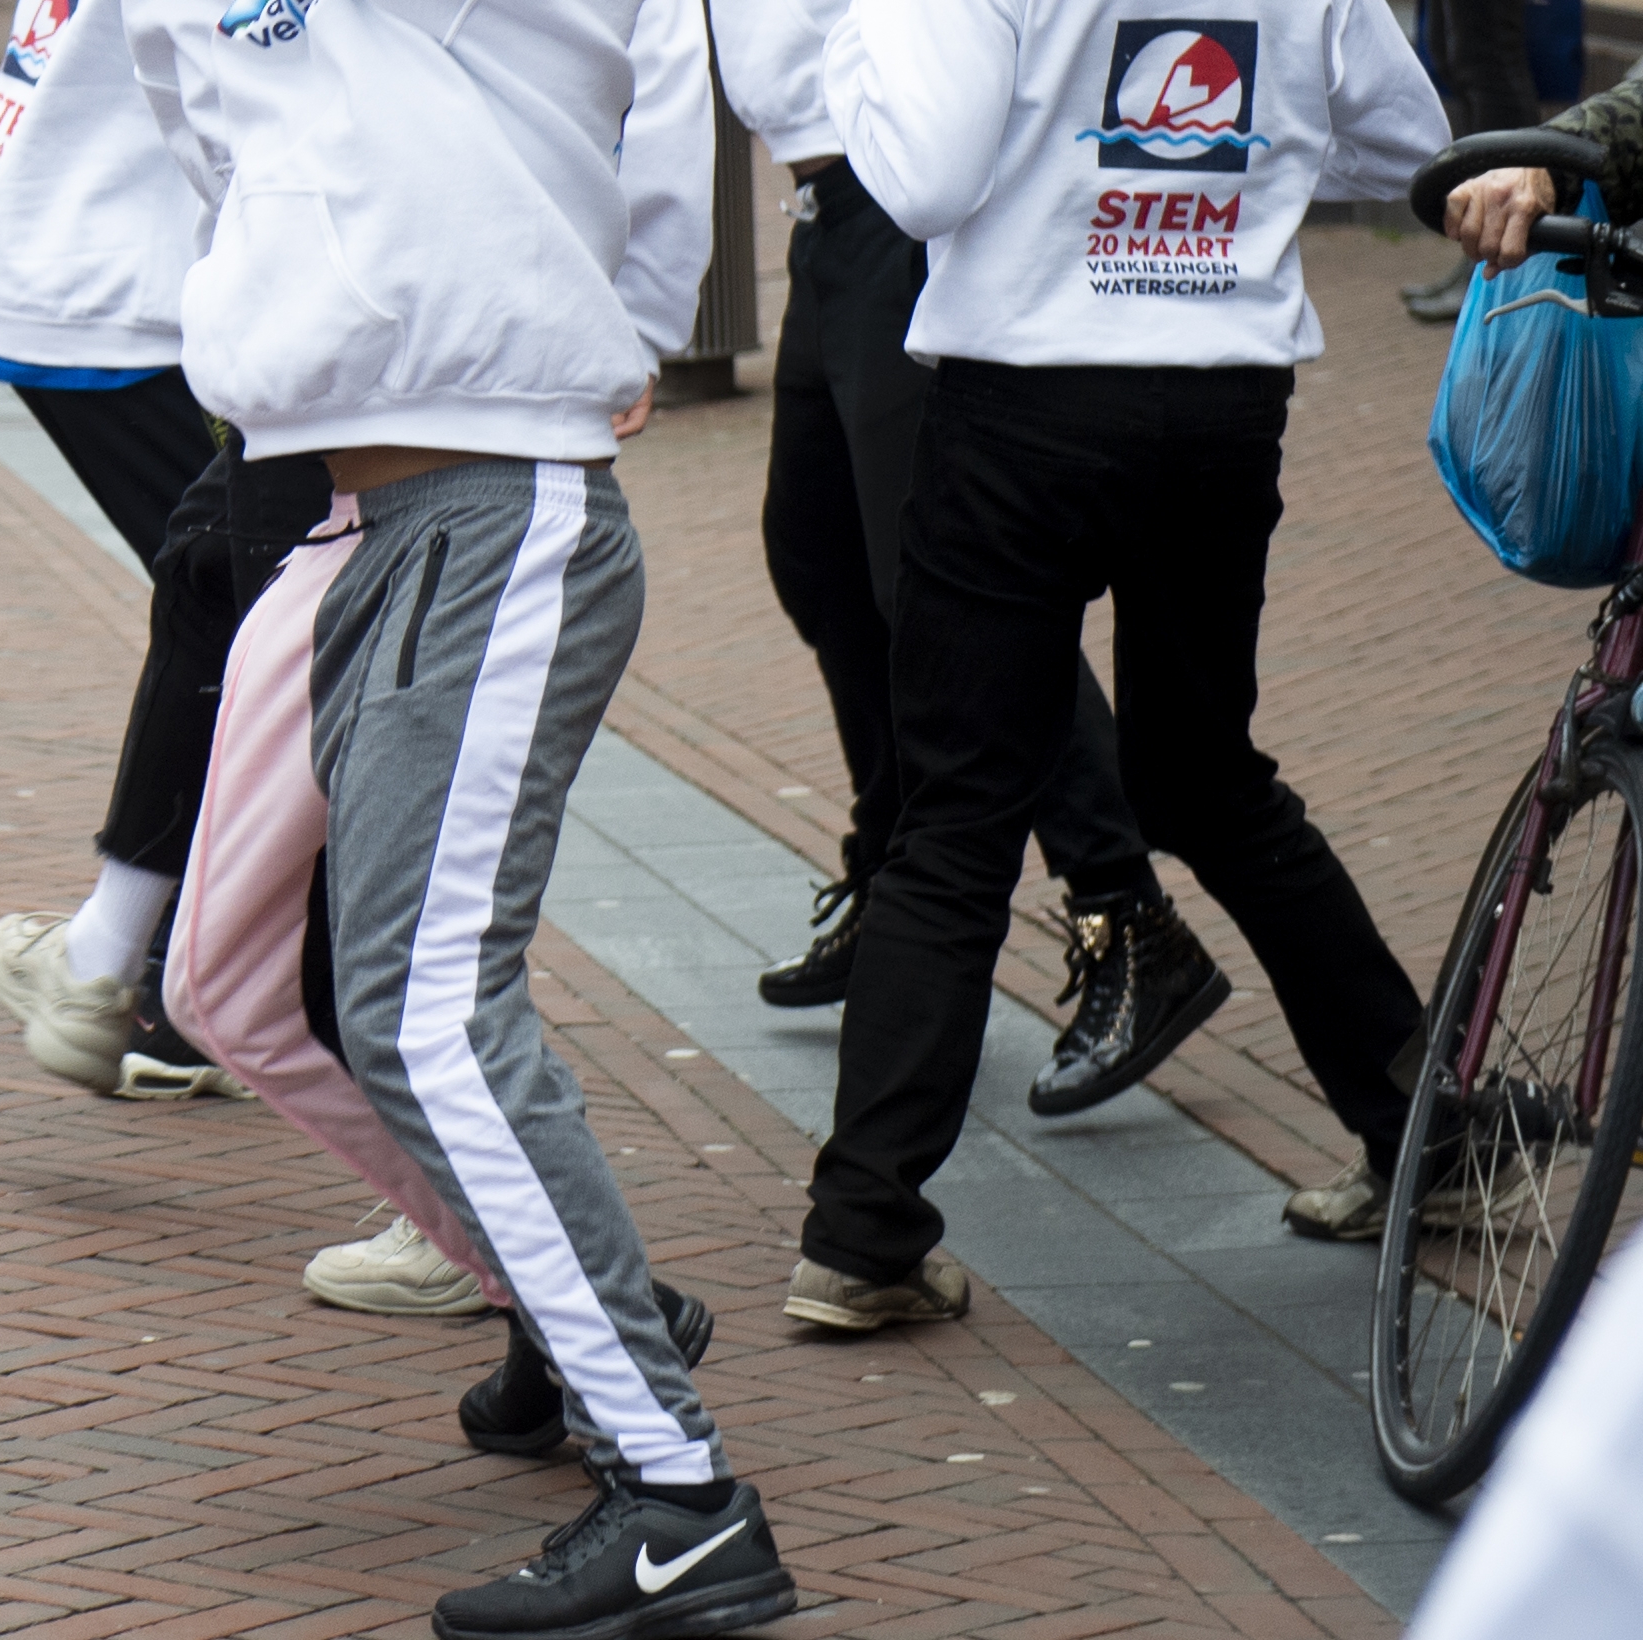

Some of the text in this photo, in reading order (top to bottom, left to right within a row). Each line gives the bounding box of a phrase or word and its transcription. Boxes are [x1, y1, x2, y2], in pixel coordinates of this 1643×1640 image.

[1090, 189, 1242, 233] STEM
[1086, 233, 1234, 259] 20 MAART
[1087, 259, 1239, 276] VERKIEZINGEN
[1089, 277, 1238, 296] WATERSCHAP
